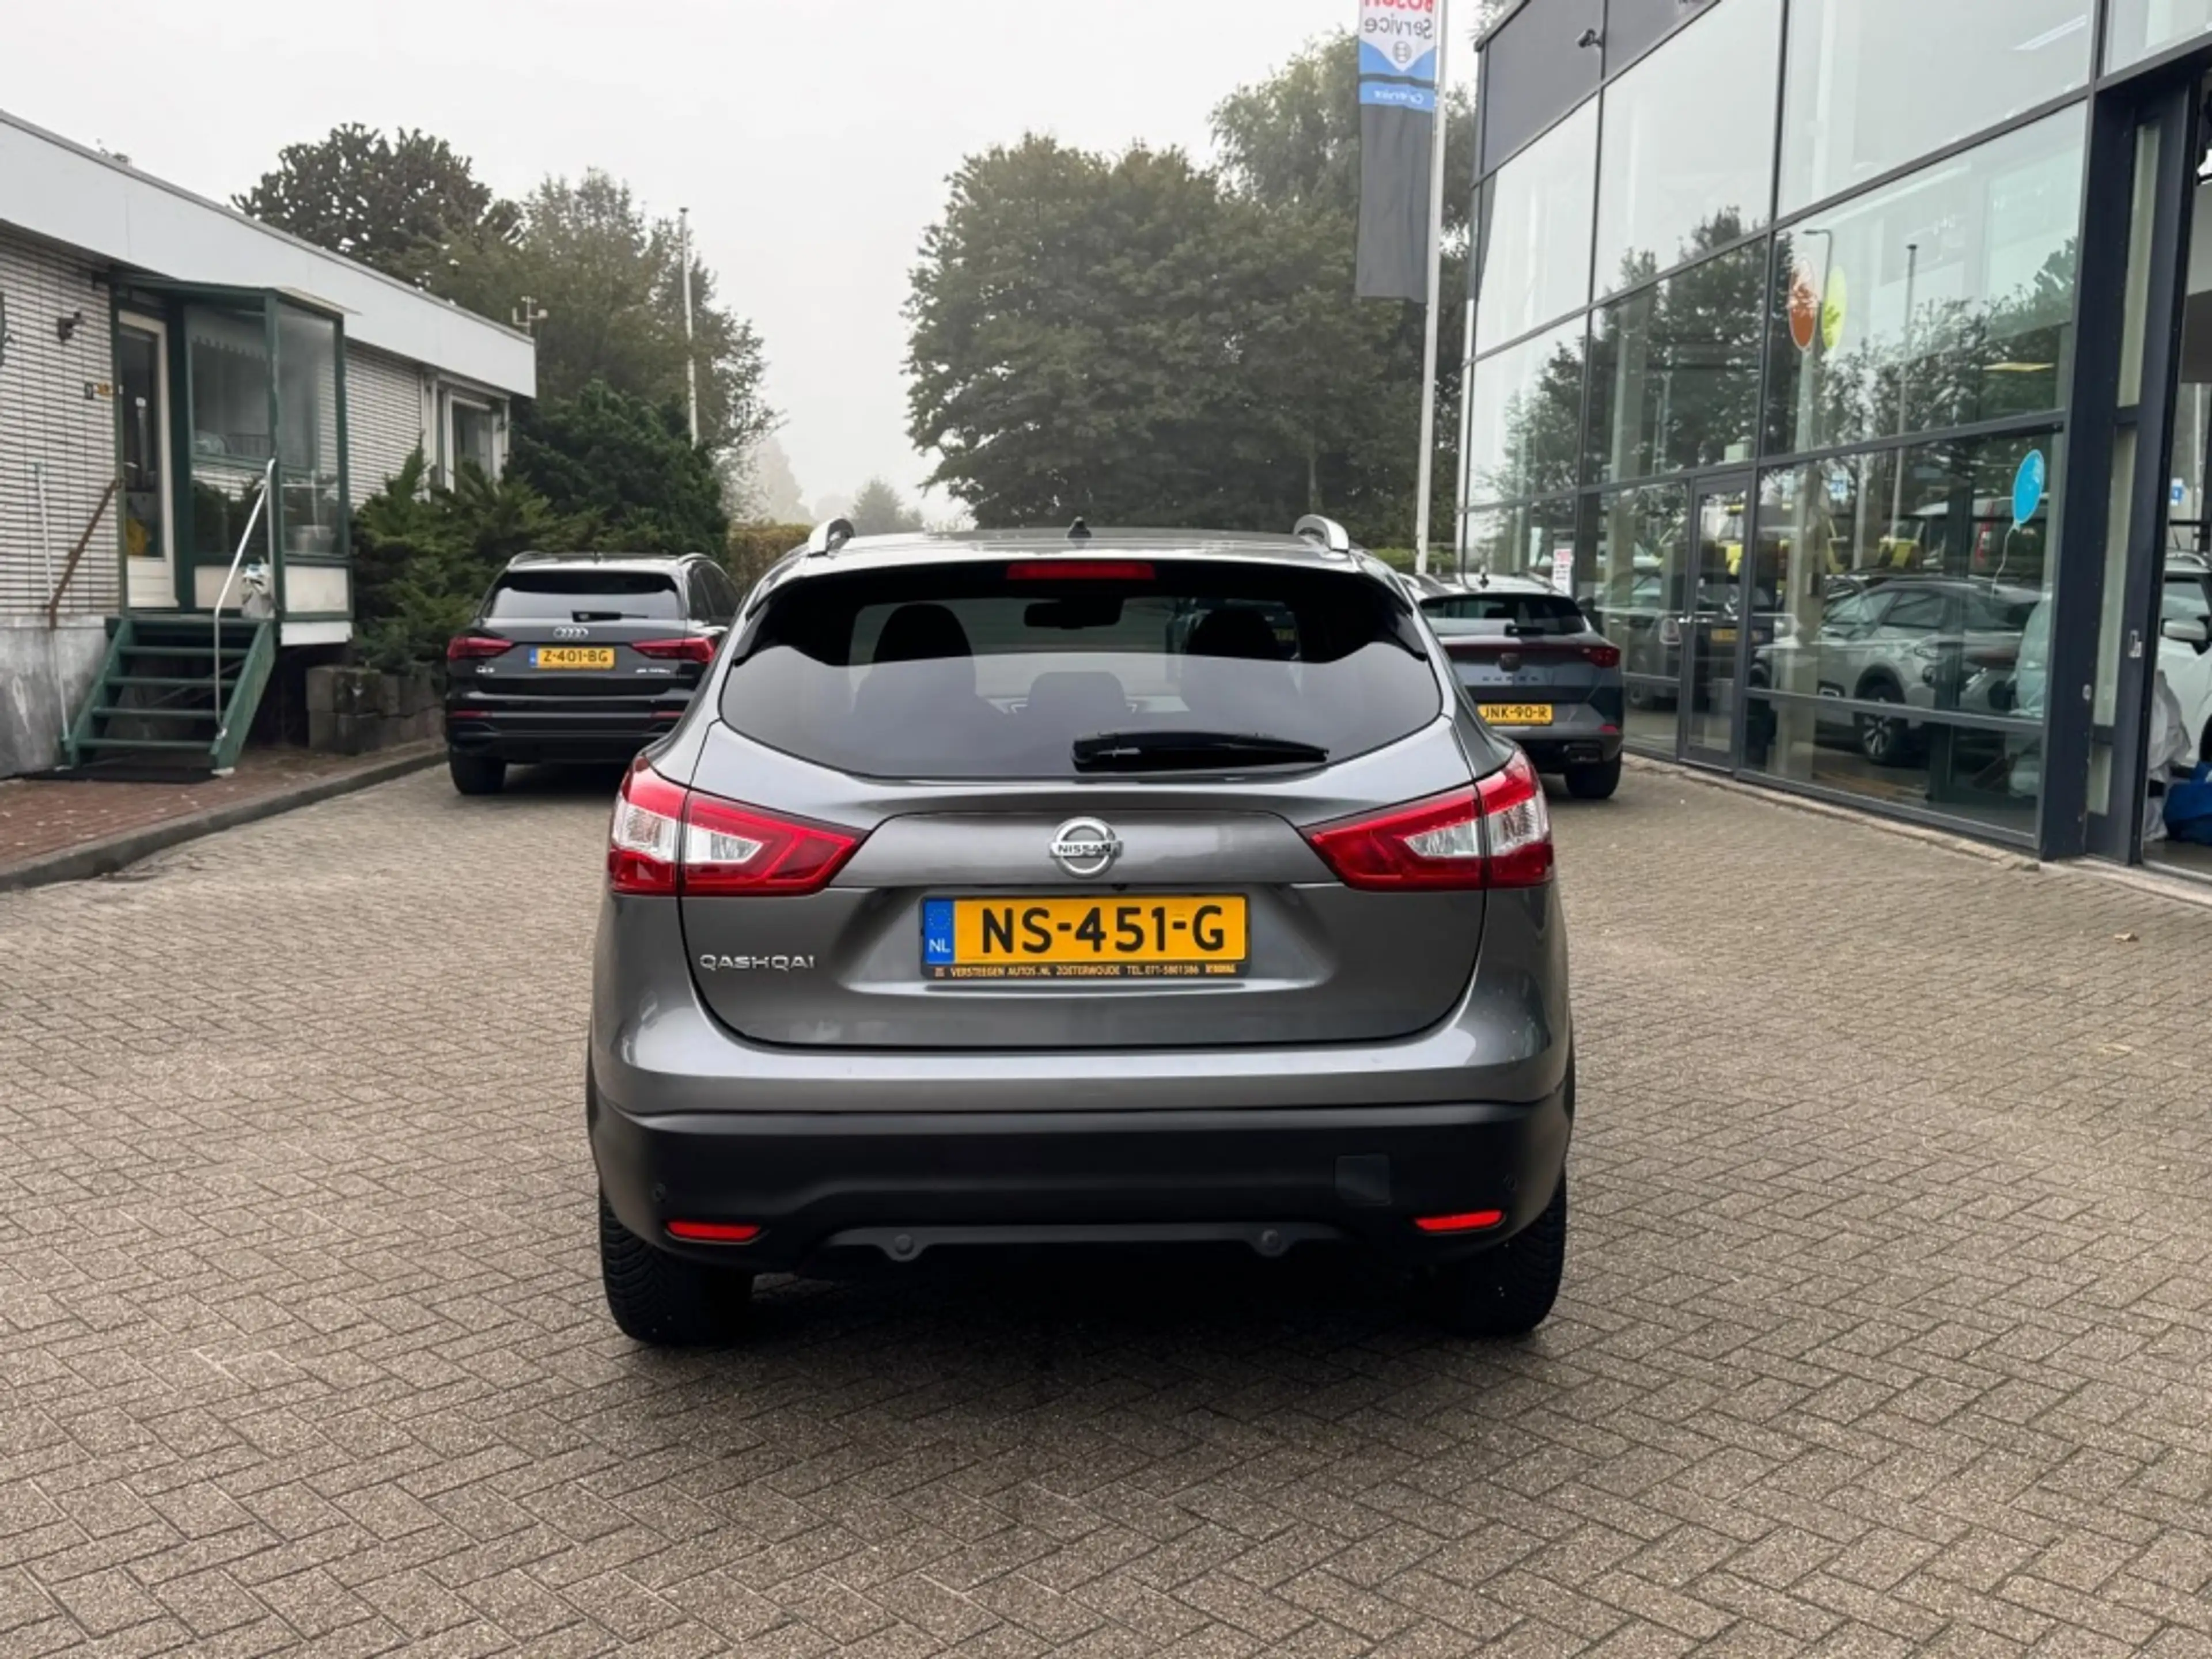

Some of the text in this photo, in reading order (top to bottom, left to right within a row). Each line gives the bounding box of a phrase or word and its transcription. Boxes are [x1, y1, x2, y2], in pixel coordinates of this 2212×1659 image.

[543, 649, 608, 662] Z-401-BG
[1058, 843, 1112, 853] NISSAN
[982, 904, 1225, 954] NS-451-G
[929, 938, 952, 953] NL
[699, 953, 815, 972] QASHQAI
